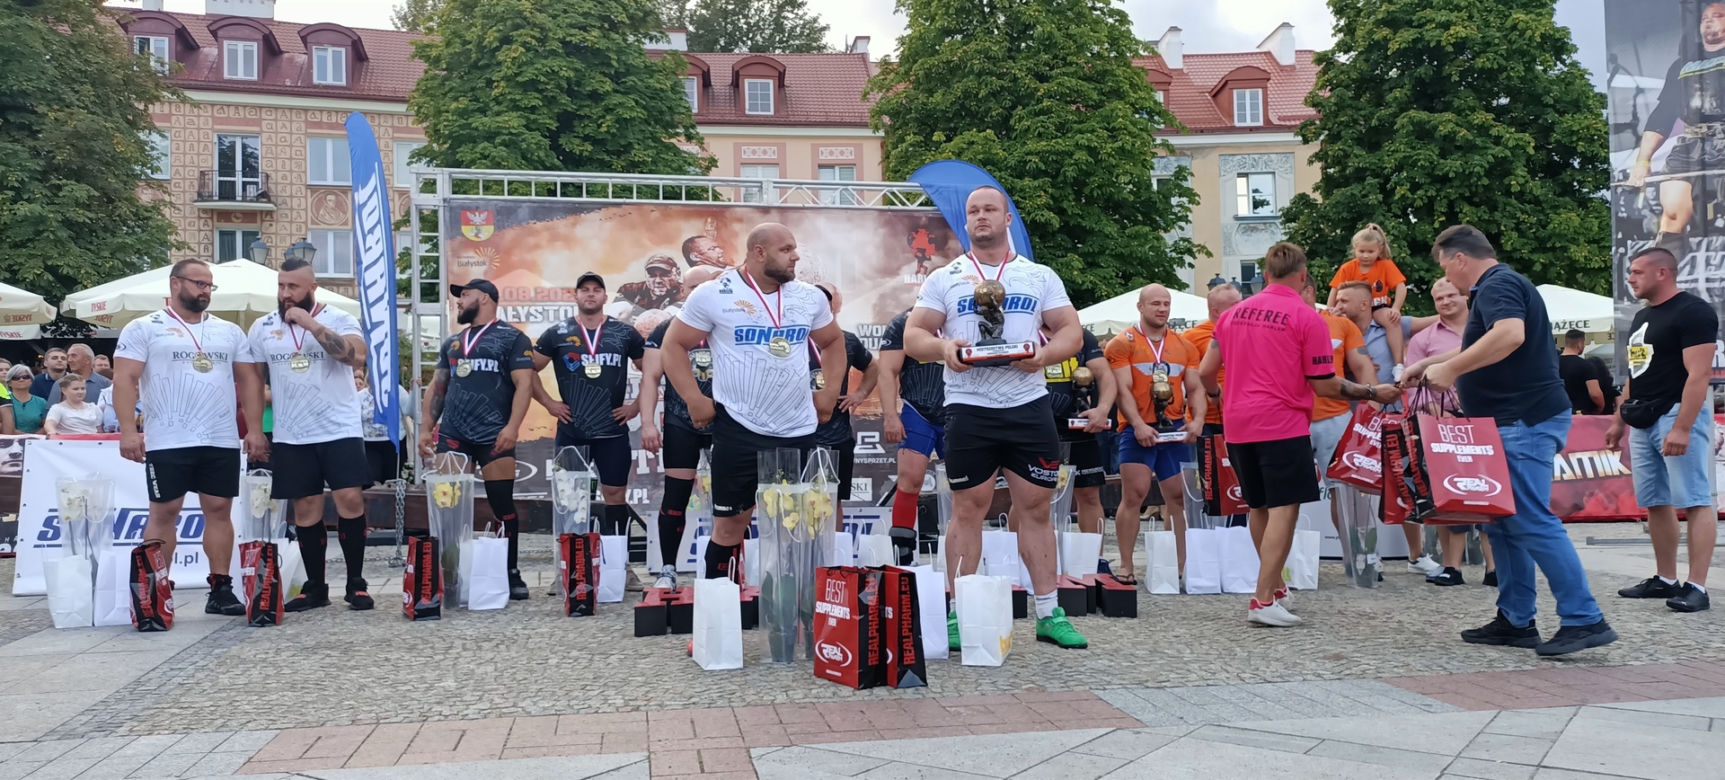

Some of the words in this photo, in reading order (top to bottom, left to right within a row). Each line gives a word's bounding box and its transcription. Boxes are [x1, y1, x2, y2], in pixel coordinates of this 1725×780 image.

[1233, 307, 1291, 326] REFEREE
[172, 351, 229, 361] ROGWSKI
[1353, 422, 1382, 442] SUPPLE
[1437, 423, 1474, 444] BEST
[1430, 442, 1495, 456] SUPPLEMENTS
[825, 578, 846, 603] BEST
[815, 601, 851, 620] SUPPLEMENTS
[901, 576, 916, 665] REALPHARM.EU
